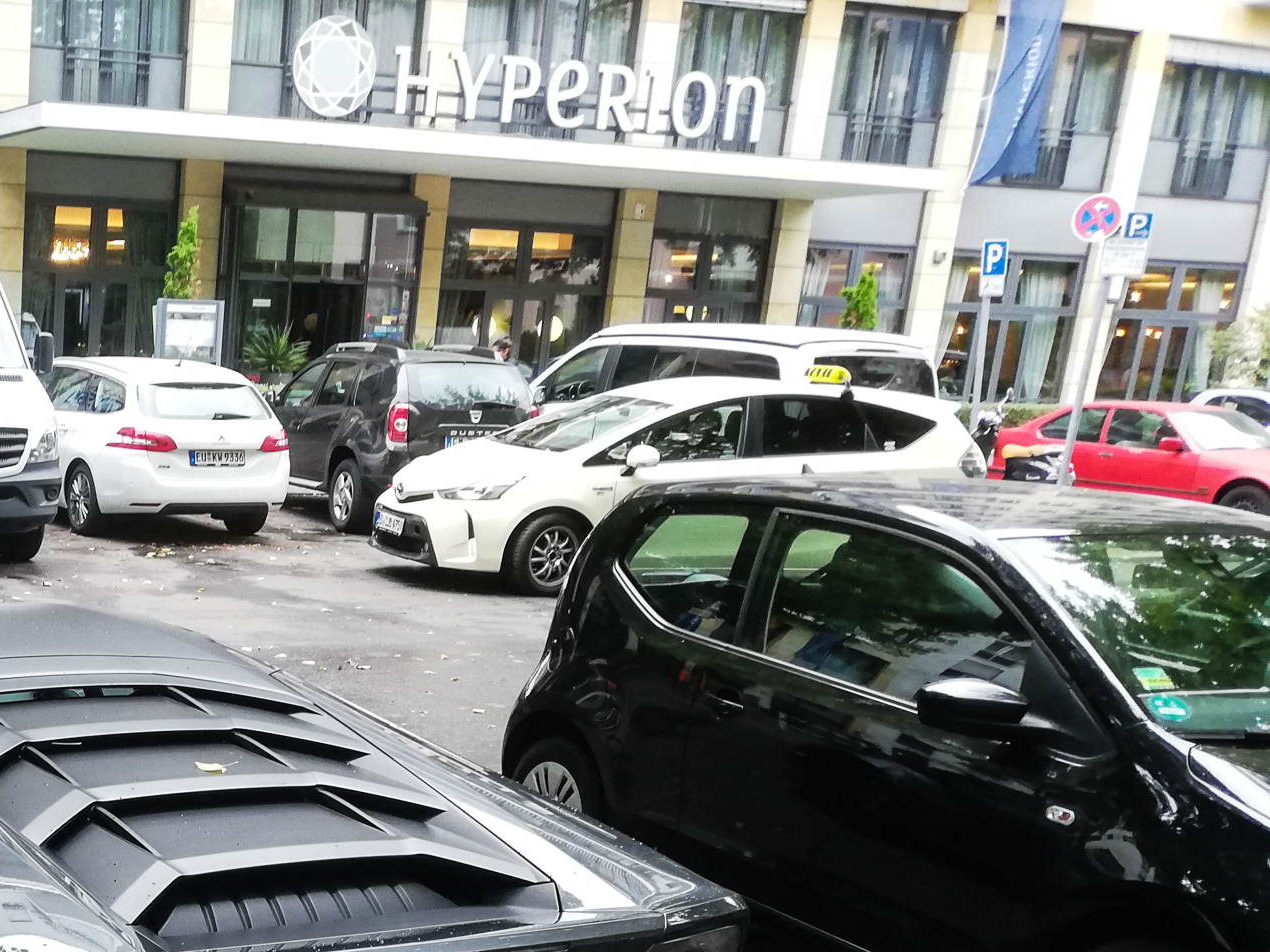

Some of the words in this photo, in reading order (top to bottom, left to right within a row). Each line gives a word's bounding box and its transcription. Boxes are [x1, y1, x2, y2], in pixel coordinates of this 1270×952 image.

[1128, 214, 1148, 237] P
[986, 243, 1003, 274] P
[195, 452, 207, 463] EU
